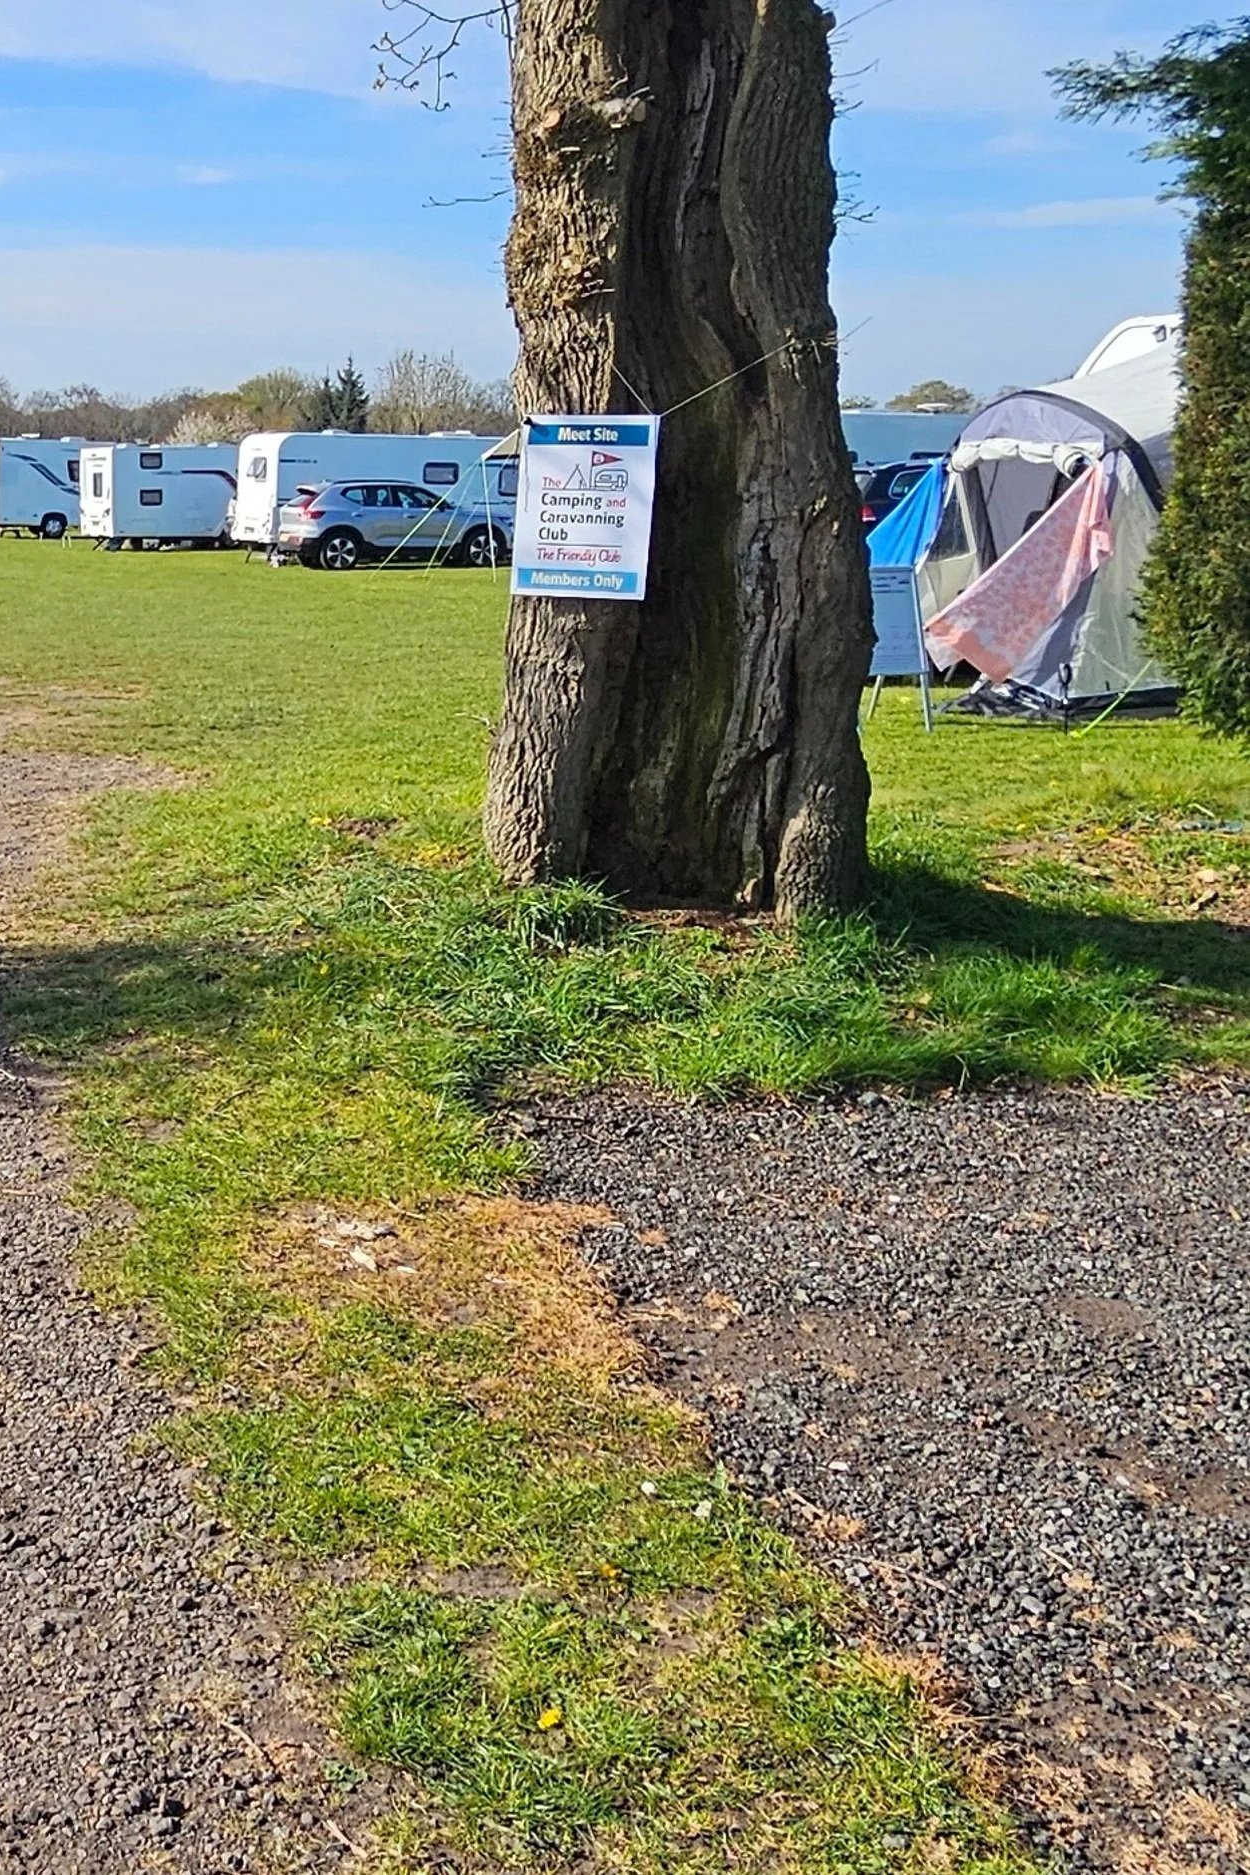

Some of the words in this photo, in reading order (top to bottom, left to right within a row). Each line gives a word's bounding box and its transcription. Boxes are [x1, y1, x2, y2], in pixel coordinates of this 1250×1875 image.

[558, 426, 591, 442] Meet
[593, 426, 619, 442] Site
[542, 476, 562, 488] The
[541, 492, 602, 510] Camping
[606, 498, 627, 508] and
[540, 510, 625, 528] Caravanning
[538, 526, 568, 541] Club
[537, 547, 554, 561] The
[556, 548, 597, 568] Friendly
[598, 548, 622, 563] Club
[530, 571, 590, 587] Members
[593, 573, 624, 591] Only
